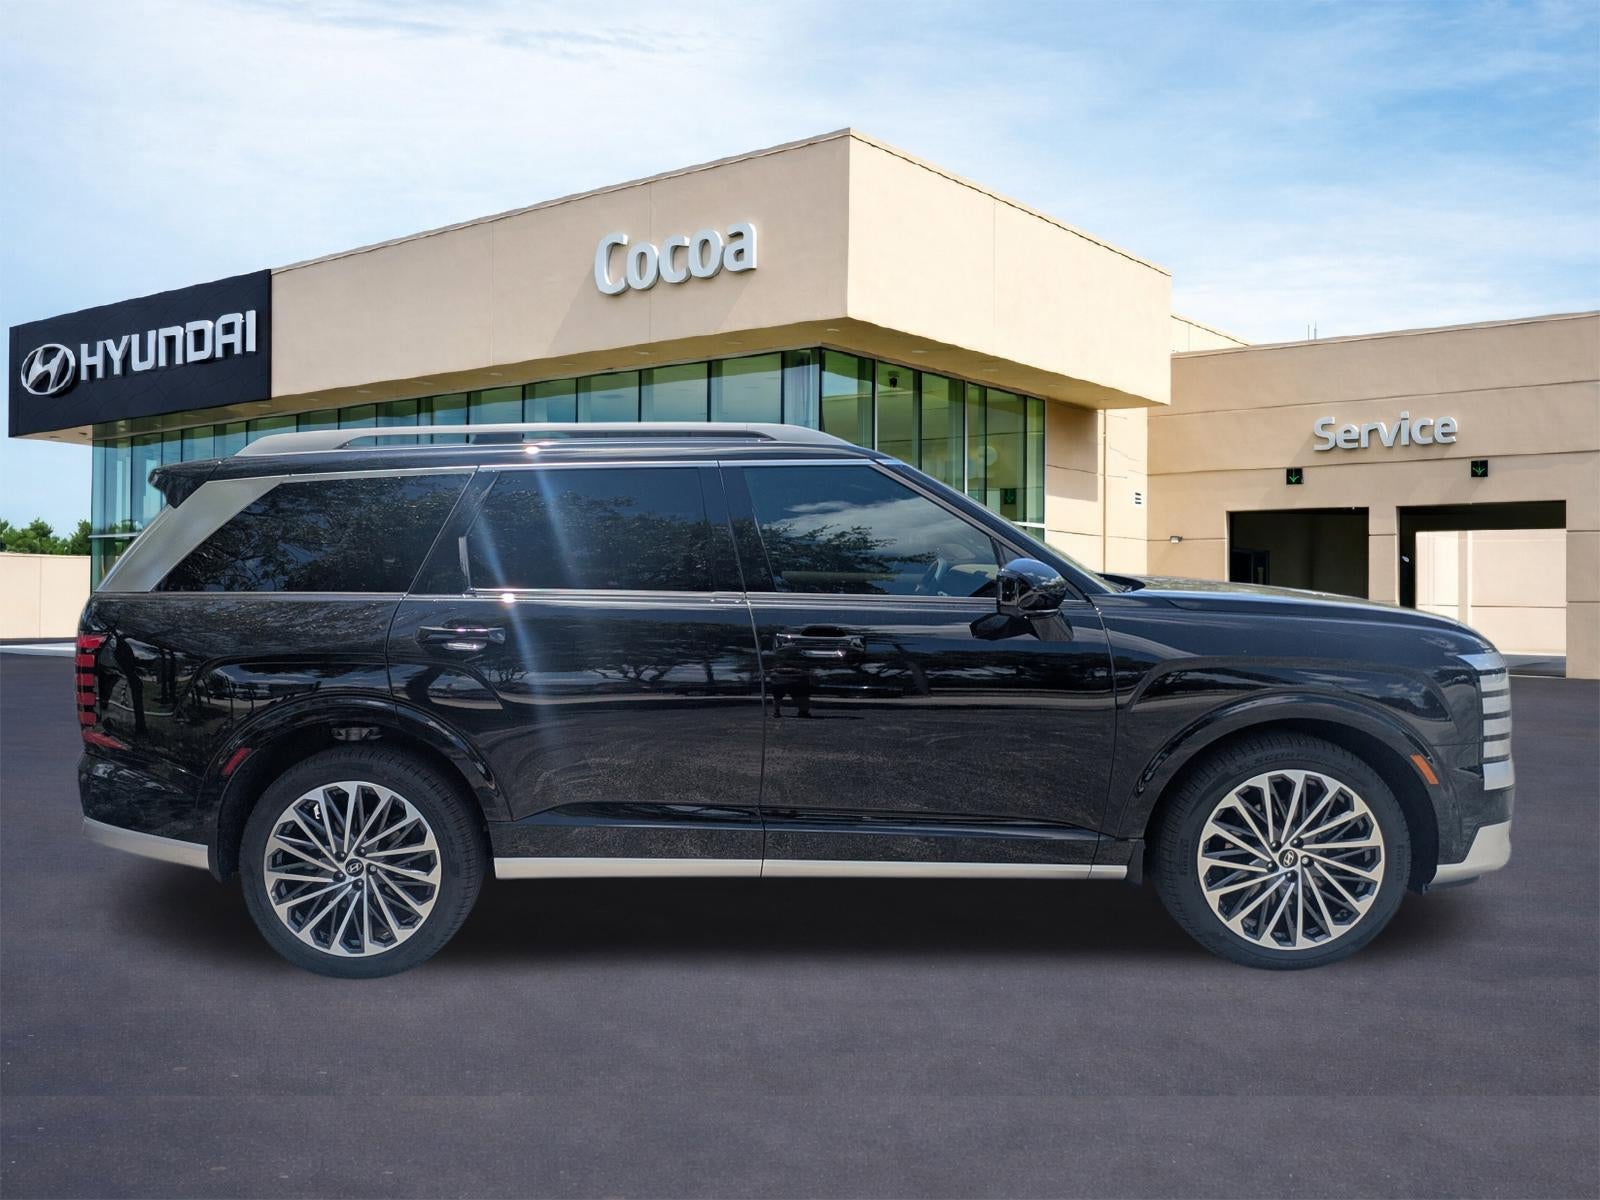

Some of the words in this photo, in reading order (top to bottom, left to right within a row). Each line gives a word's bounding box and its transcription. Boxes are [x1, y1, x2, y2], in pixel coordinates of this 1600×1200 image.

[594, 223, 757, 295] Cocoa
[80, 310, 257, 381] HYUNDAI
[1313, 411, 1458, 451] Service
